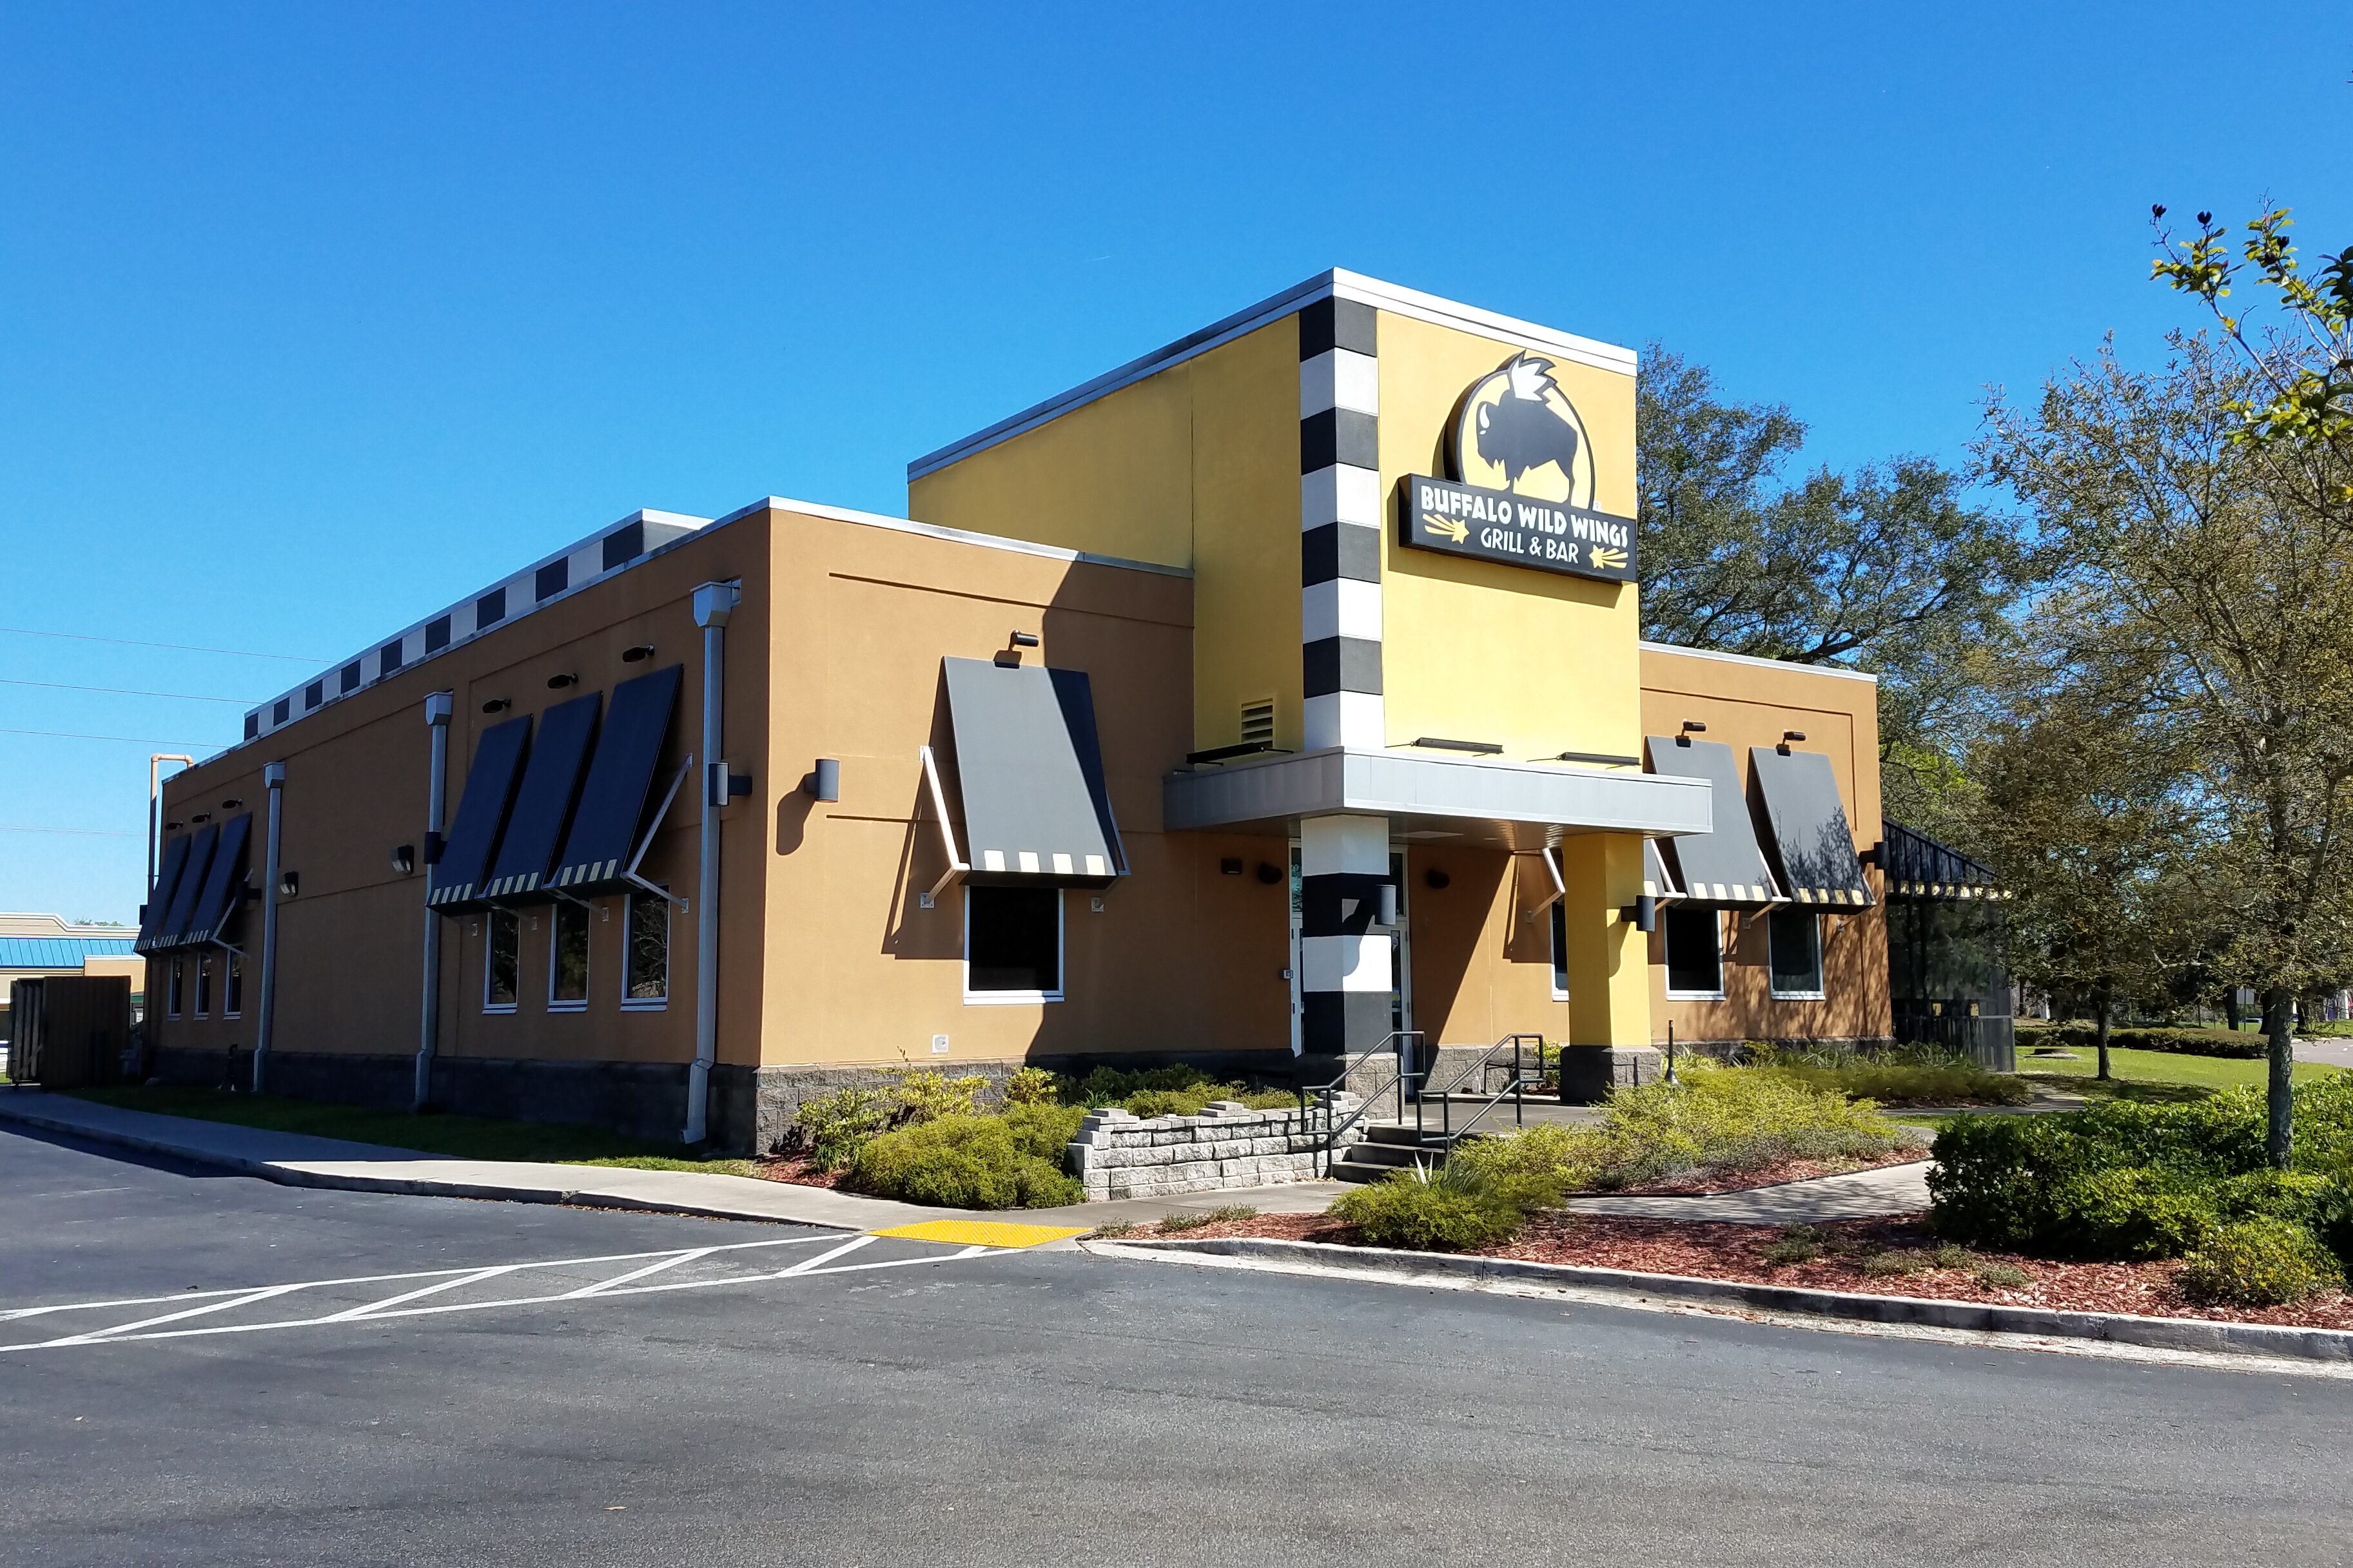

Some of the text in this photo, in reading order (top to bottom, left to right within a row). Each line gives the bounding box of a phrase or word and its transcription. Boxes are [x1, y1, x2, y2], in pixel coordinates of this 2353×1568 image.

[1421, 485, 1628, 547] BUFFALO WILD WINGS
[1481, 527, 1578, 563] GRILL & BAR
